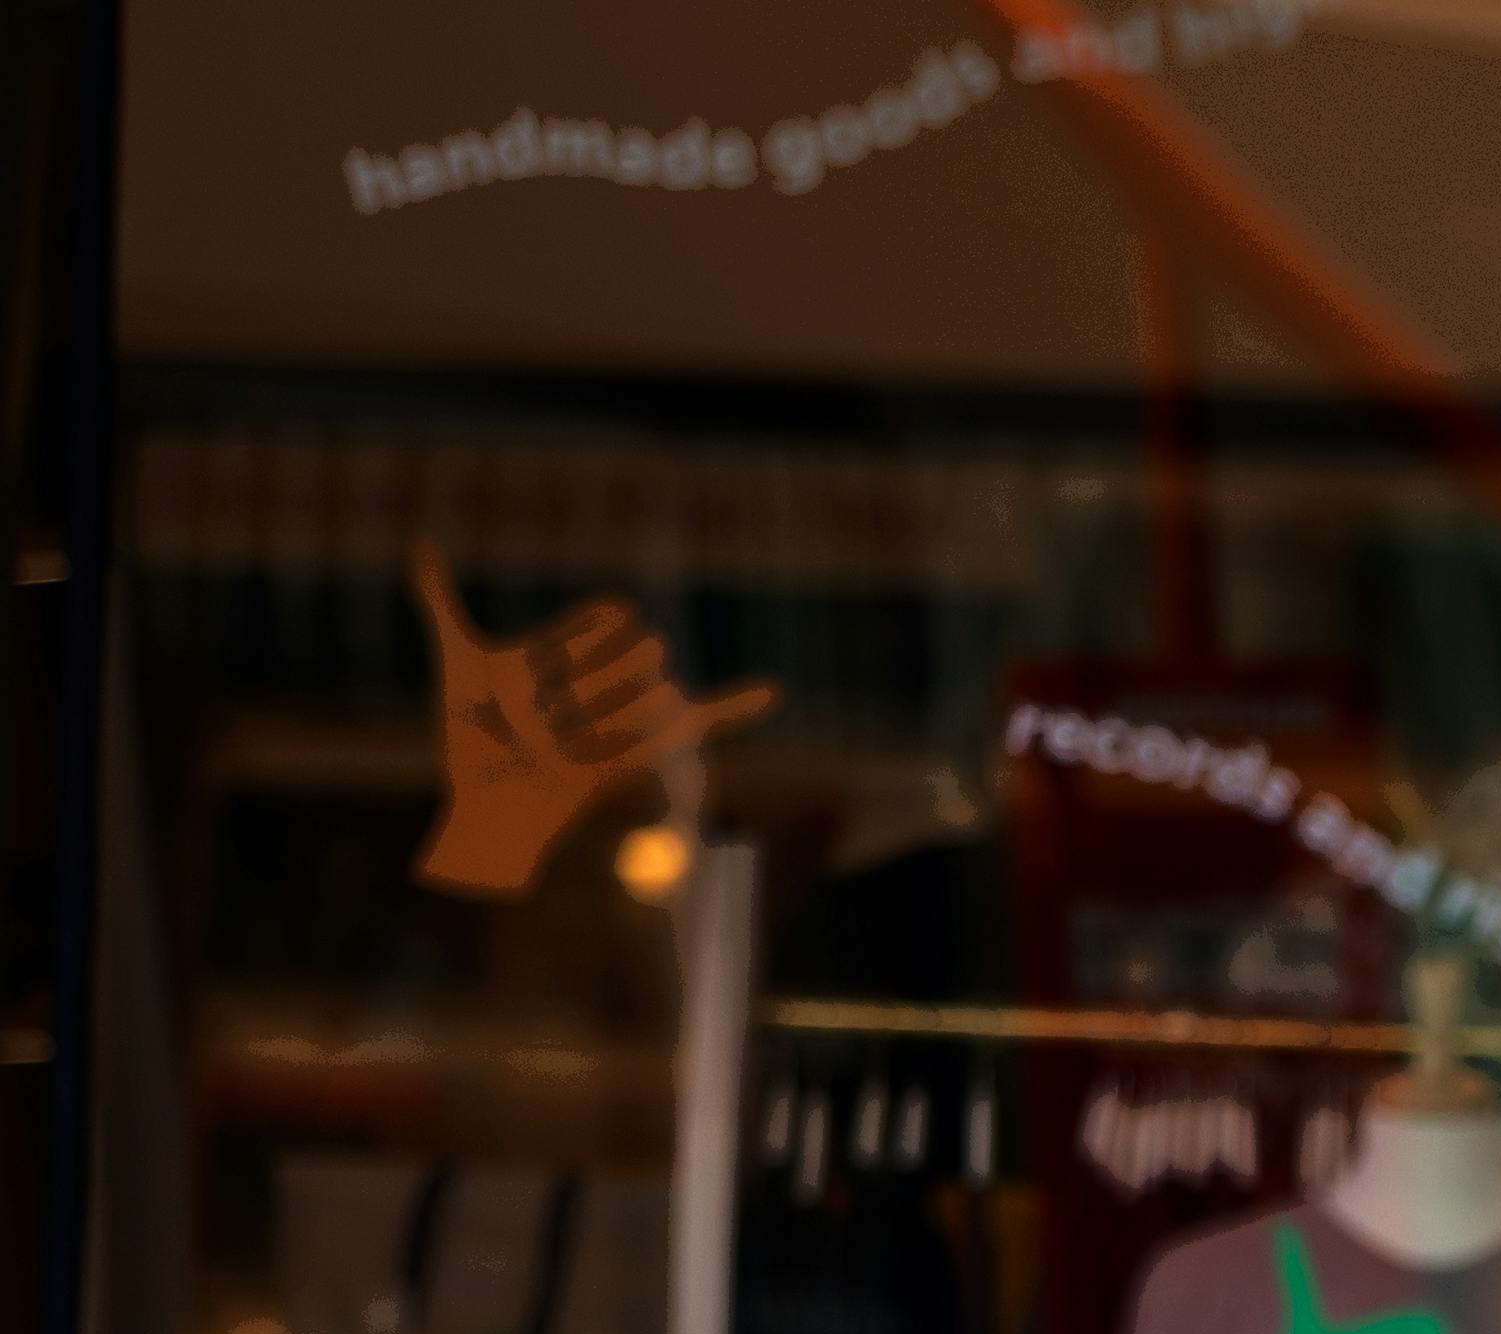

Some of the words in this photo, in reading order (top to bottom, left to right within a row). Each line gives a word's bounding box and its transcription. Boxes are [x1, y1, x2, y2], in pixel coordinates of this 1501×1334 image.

[342, 105, 757, 214] handmade
[762, 38, 998, 196] goods
[1006, 704, 1303, 822] records
[1298, 789, 1444, 912] and
